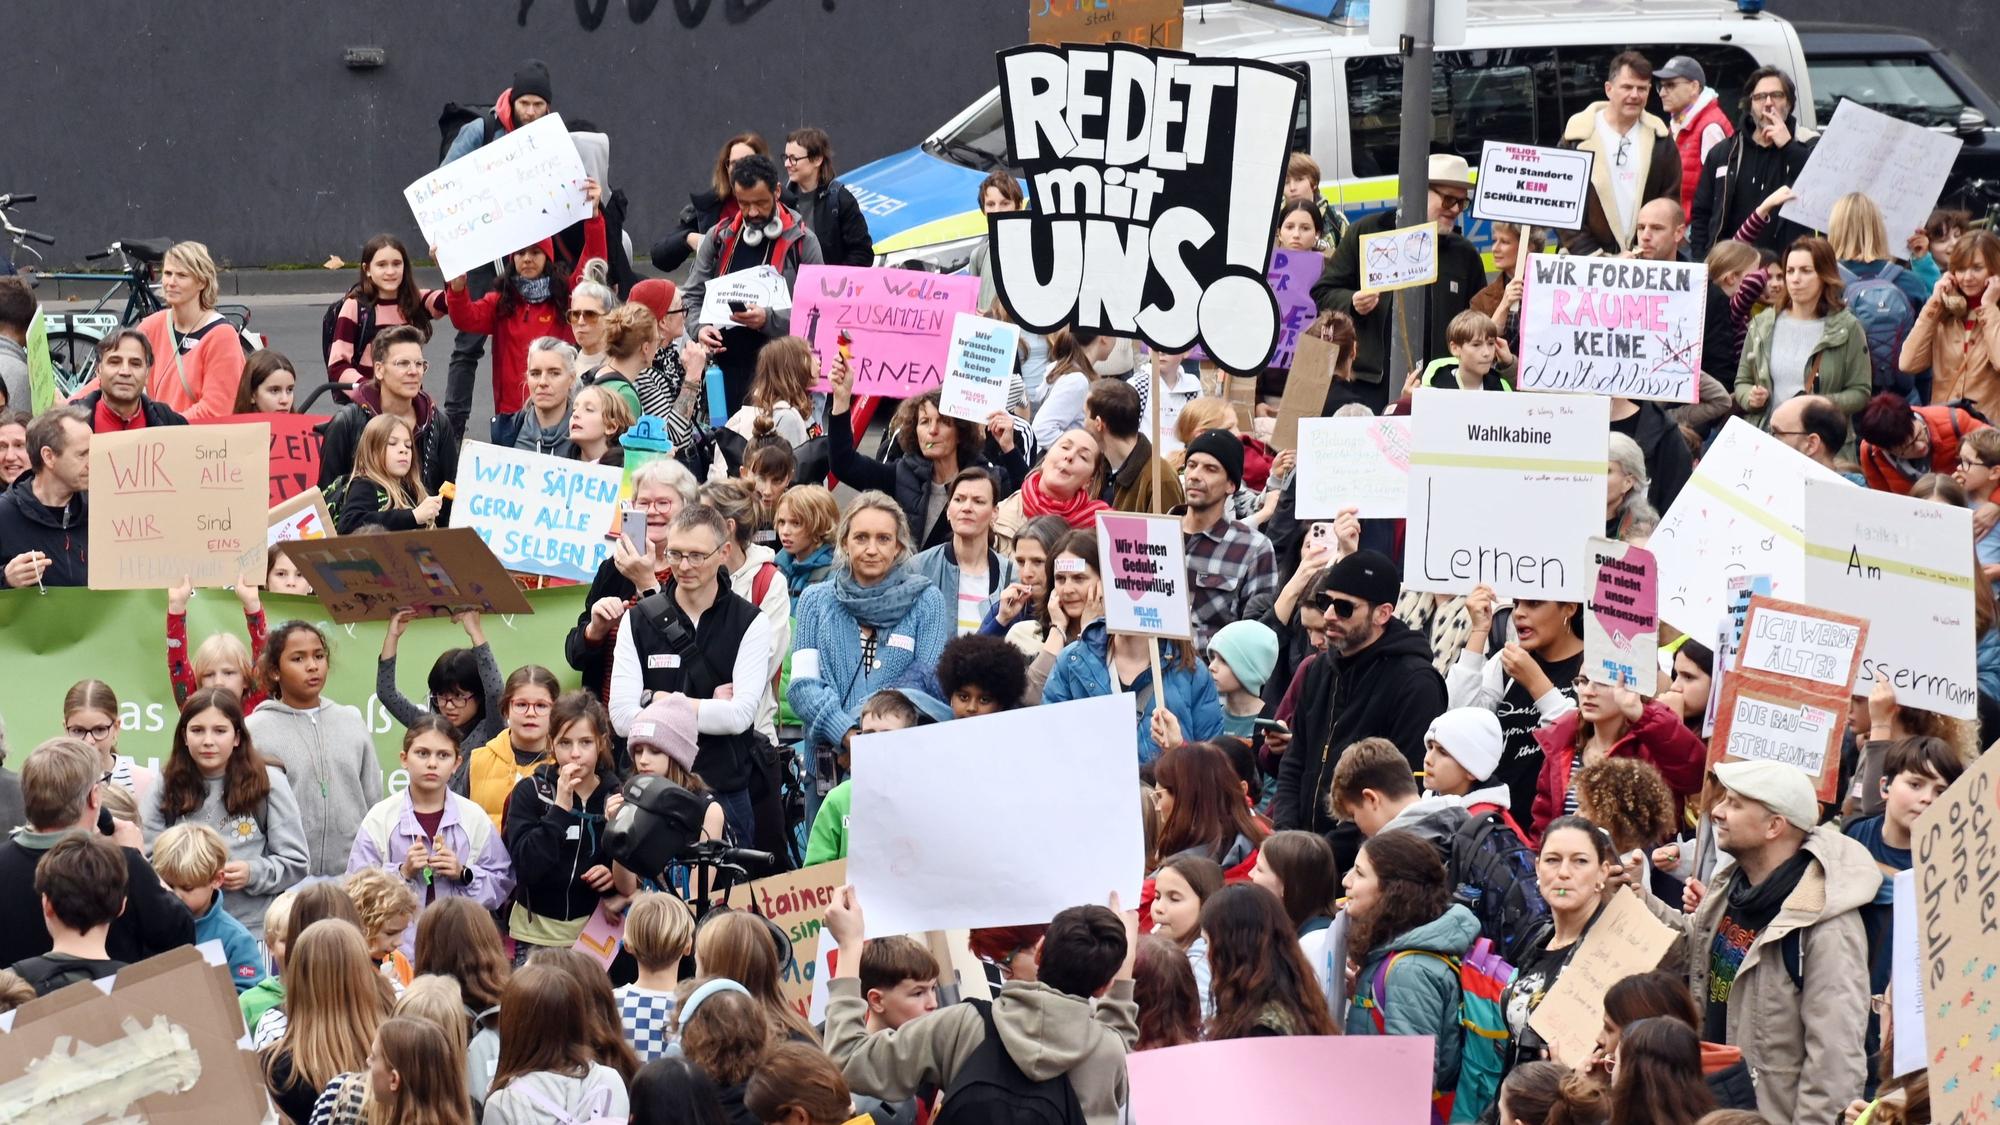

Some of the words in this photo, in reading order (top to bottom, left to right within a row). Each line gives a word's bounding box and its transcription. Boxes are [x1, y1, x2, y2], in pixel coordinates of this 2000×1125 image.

[1004, 50, 1236, 171] REDET
[1505, 146, 1537, 156] HELIOS
[1510, 154, 1541, 164] JETZT!
[1495, 165, 1518, 176] Drei
[1520, 168, 1573, 181] Standorte
[1034, 164, 1164, 221] mit
[1516, 180, 1548, 193] KEIN
[1484, 191, 1577, 210] SCHÜLERTICKET!
[1536, 257, 1577, 287] WIR
[1587, 263, 1691, 293] FORDERN
[821, 276, 865, 299] Wir
[883, 276, 950, 301] Wollen
[836, 303, 945, 332] ZUSAMMEN
[1551, 286, 1669, 333] RÄUME
[958, 338, 1006, 356] brauchen
[975, 331, 993, 342] Wir
[1574, 328, 1647, 360] KEINE
[962, 350, 997, 365] Räume
[964, 361, 992, 375] keine
[1523, 342, 1690, 398] Luftschlösser
[952, 369, 1003, 388] Ausreden!
[1467, 424, 1553, 446] Wahlkabine
[108, 442, 173, 490] WIR
[195, 439, 227, 461] Sind
[200, 464, 243, 487] Alle
[474, 456, 526, 490] WIR
[111, 514, 161, 539] WIR
[197, 507, 231, 532] Sind
[468, 493, 524, 522] GERN
[534, 506, 591, 533] ALLE
[1424, 476, 1565, 589] Lernen
[207, 541, 241, 552] EINS
[503, 530, 586, 567] SELBEN
[1115, 539, 1132, 554] Wir
[1134, 540, 1167, 556] lernen
[1122, 558, 1158, 574] Geduld
[1595, 553, 1646, 577] Stillstand
[1846, 544, 1882, 581] Am
[1114, 576, 1176, 597] unfreiwillig!
[1598, 570, 1613, 584] ist
[1614, 575, 1642, 592] nicht
[1133, 605, 1158, 617] HELIOS
[1604, 590, 1636, 606] unser
[1587, 599, 1654, 628] Lernkonzept!
[1756, 615, 1798, 644] ICH
[1799, 620, 1858, 651] WERDE
[1764, 644, 1837, 680] ÄLTER
[1862, 658, 1976, 706] ssermann
[1738, 701, 1768, 727] DIE
[1949, 801, 1969, 904] ohne
[1968, 772, 2000, 935] Schüler
[1919, 823, 1952, 990] Schule
